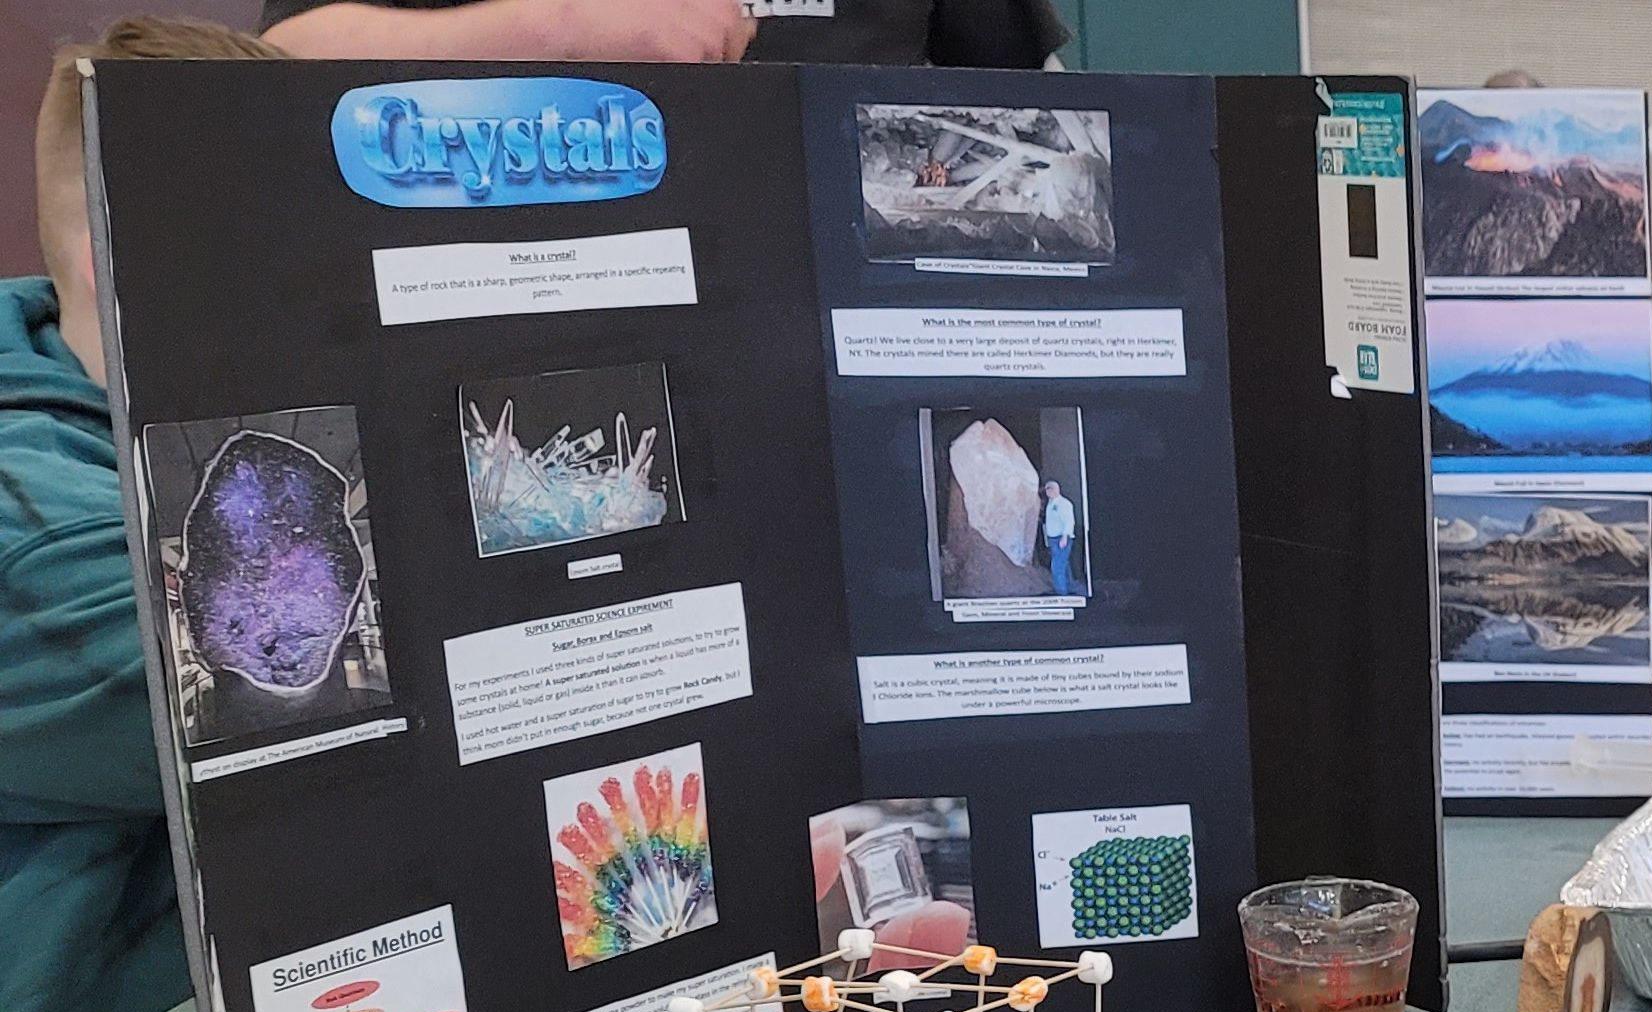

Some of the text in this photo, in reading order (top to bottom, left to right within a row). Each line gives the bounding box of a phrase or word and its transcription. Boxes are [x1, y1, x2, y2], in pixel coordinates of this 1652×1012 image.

[356, 96, 662, 190] Crystals
[508, 253, 531, 262] What
[546, 249, 575, 260] crystal?
[399, 284, 418, 294] type
[430, 281, 448, 290] rock
[449, 280, 466, 289] that
[482, 277, 507, 287] sharp,
[508, 275, 547, 287] geometric
[548, 273, 573, 282] shape,
[575, 269, 607, 280] arranged
[624, 266, 651, 277] specific
[652, 265, 685, 275] repeating
[532, 289, 561, 300] pattern.
[921, 318, 945, 326] What
[957, 318, 971, 327] the
[973, 319, 995, 327] most
[997, 319, 1035, 327] common
[1036, 319, 1056, 327] type
[1069, 318, 1101, 327] crystal?
[1348, 321, 1407, 336] FOAM BOARD
[844, 336, 877, 345] Quartz!
[895, 336, 910, 345] live
[912, 336, 934, 345] close
[955, 338, 973, 347] very
[975, 336, 996, 347] large
[998, 337, 1029, 346] deposit
[1042, 337, 1068, 346] quartz
[1070, 338, 1104, 346] crystals,
[1106, 337, 1125, 346] right
[1137, 338, 1176, 346] Herkimer,
[848, 349, 861, 357] NY.
[864, 349, 880, 357] The
[882, 350, 915, 359] crystals
[917, 349, 944, 358] mined
[945, 349, 968, 357] there
[986, 349, 1011, 358] called
[1013, 349, 1051, 357] Herkimer
[1053, 349, 1098, 359] Diamonds,
[1099, 349, 1113, 358] but
[1116, 350, 1134, 360] they
[1151, 350, 1173, 360] really
[983, 363, 1044, 372] quartz crystals.
[524, 598, 672, 636] SUPER SATURATED SCIENCE EXPIREMENT
[933, 660, 957, 669] What
[967, 659, 1000, 667] another
[1002, 658, 1021, 666] type
[1034, 657, 1070, 665] common
[1072, 653, 1103, 663] crystal?
[873, 680, 888, 689] Salt
[906, 679, 928, 688] cubic
[930, 678, 959, 687] crystal,
[962, 677, 997, 685] meaning
[1051, 674, 1066, 682] tiny
[1068, 672, 1091, 680] cubes
[1093, 670, 1120, 680] bound
[1154, 669, 1183, 677] sodium
[877, 692, 912, 701] Chloride
[937, 689, 952, 697] The
[954, 688, 1009, 697] marshmallow
[1068, 684, 1088, 692] what
[1097, 683, 1111, 691] salt
[1113, 682, 1139, 692] crystal
[1141, 681, 1162, 689] looks
[961, 701, 985, 709] under
[995, 698, 1031, 708] powerful
[1093, 813, 1137, 823] Table Salt
[1105, 825, 1126, 834] NaCl
[272, 921, 444, 987] Scientific Method
